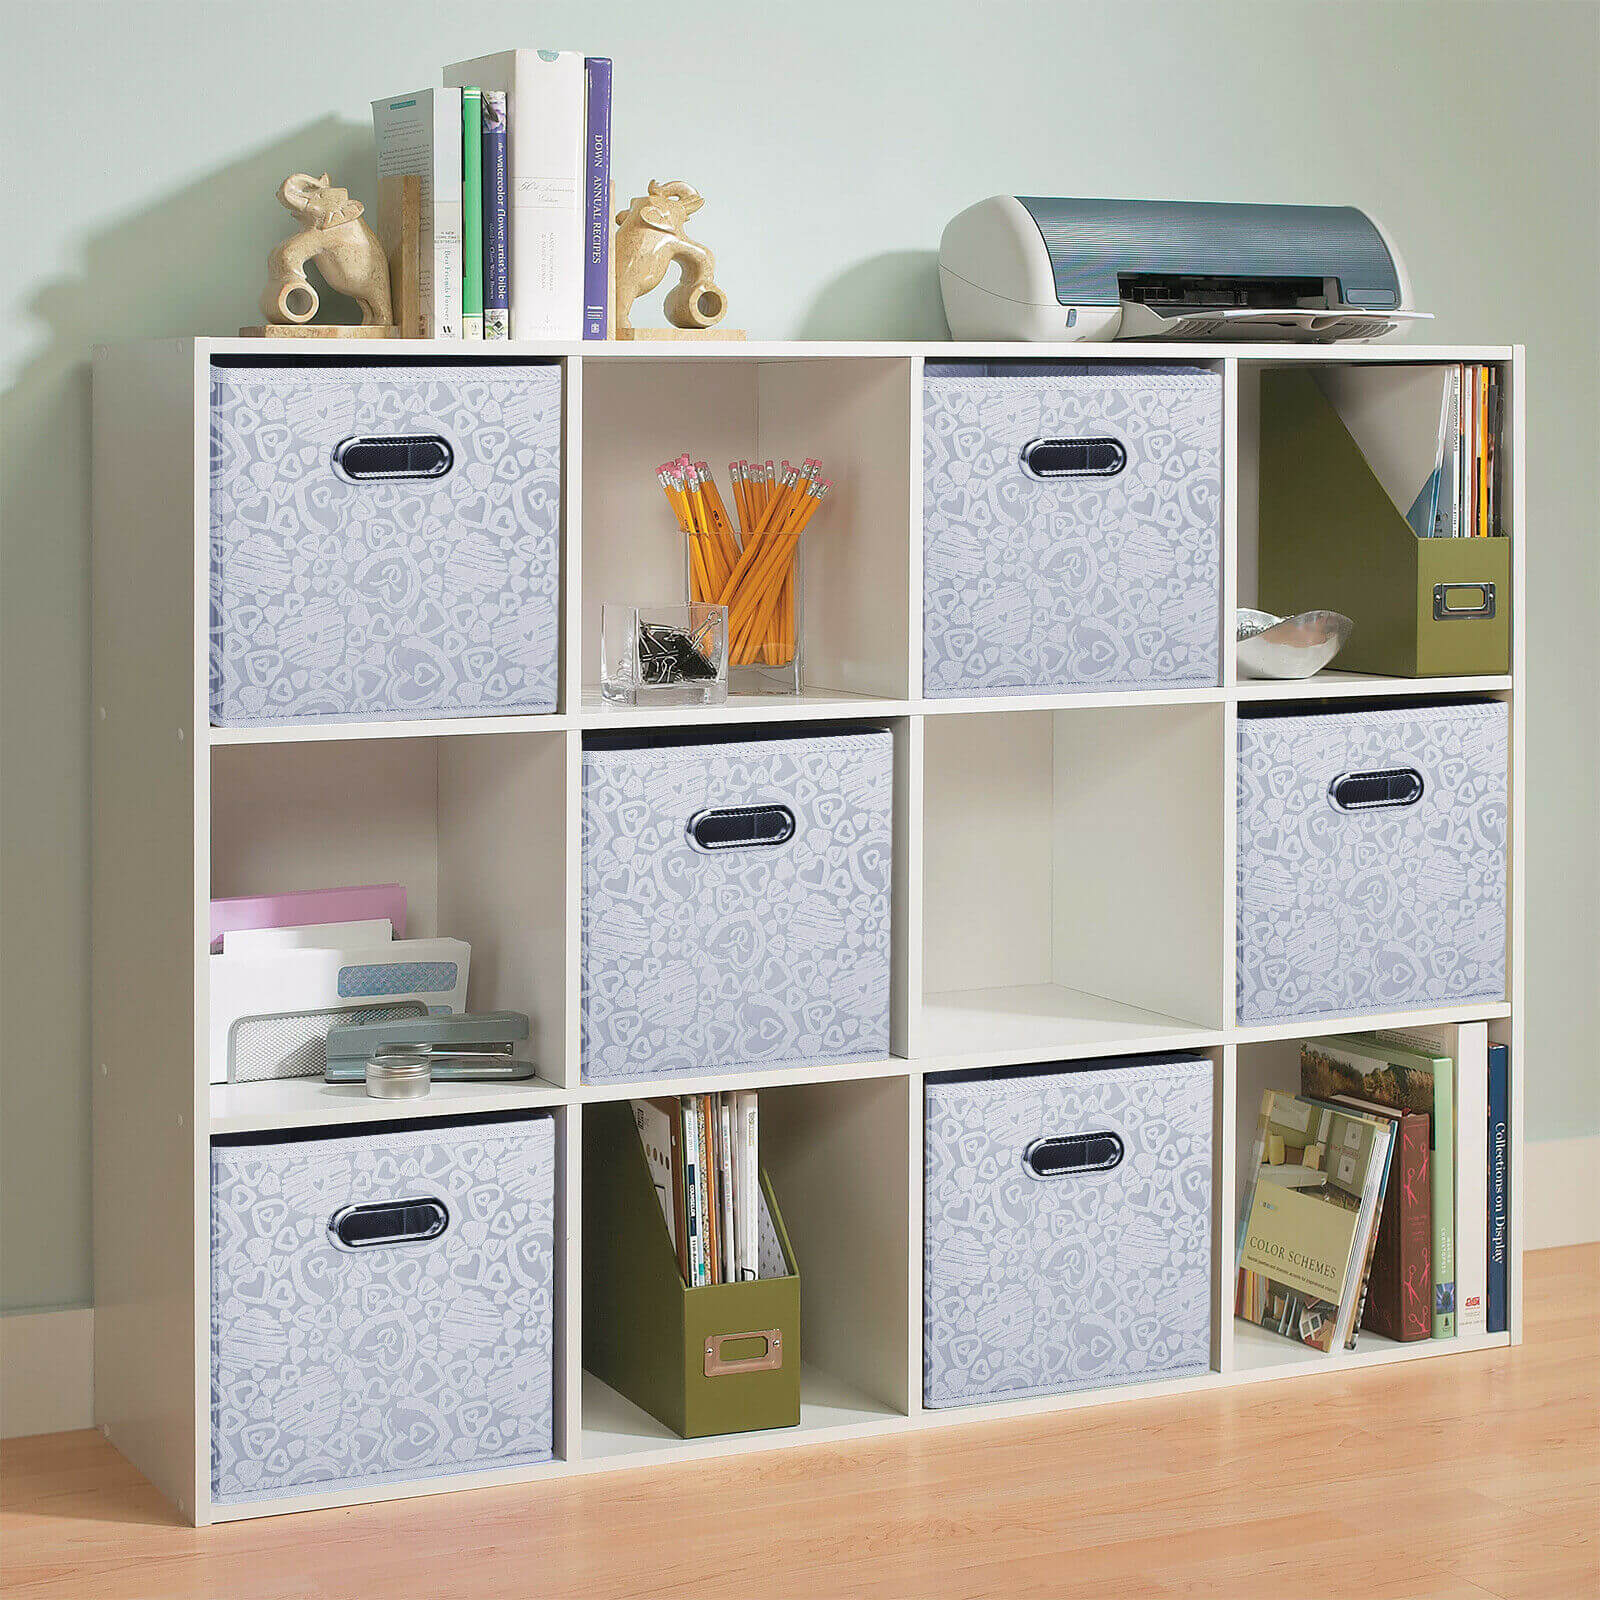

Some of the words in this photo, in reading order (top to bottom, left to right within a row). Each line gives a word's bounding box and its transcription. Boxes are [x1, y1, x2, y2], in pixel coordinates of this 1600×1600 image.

[594, 134, 603, 168] DOWN
[497, 154, 506, 205] watercolor
[593, 176, 602, 220] ANNUAL
[497, 208, 507, 241] flower
[592, 222, 602, 264] RECIPES
[497, 243, 506, 273] artist's
[497, 276, 507, 300] bible
[1494, 1121, 1506, 1193] Collections
[1494, 1195, 1504, 1212] on
[1249, 1235, 1286, 1259] COLOR
[1287, 1252, 1338, 1280] SCHEMES
[1491, 1215, 1506, 1264] Display
